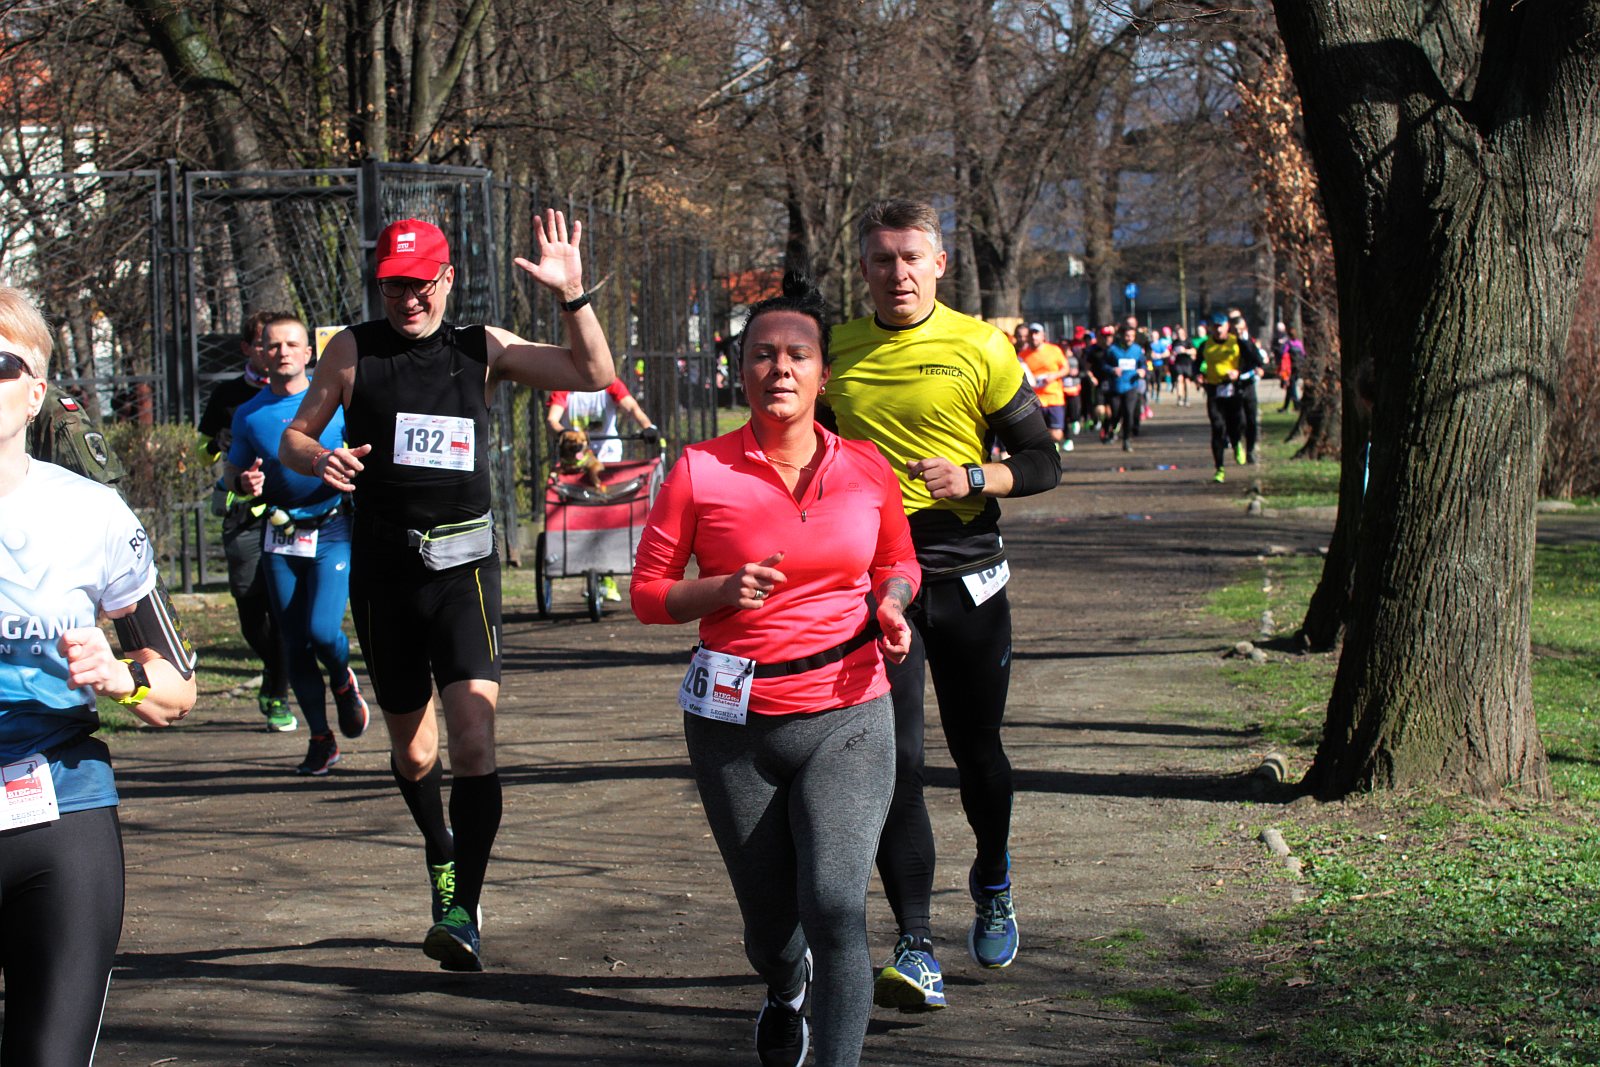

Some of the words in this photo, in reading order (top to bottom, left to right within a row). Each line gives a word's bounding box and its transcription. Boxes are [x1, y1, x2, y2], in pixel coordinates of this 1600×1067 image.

[925, 368, 963, 378] LEGNICA
[404, 427, 445, 455] 132
[682, 661, 710, 699] 26
[710, 708, 738, 719] LEGNICA
